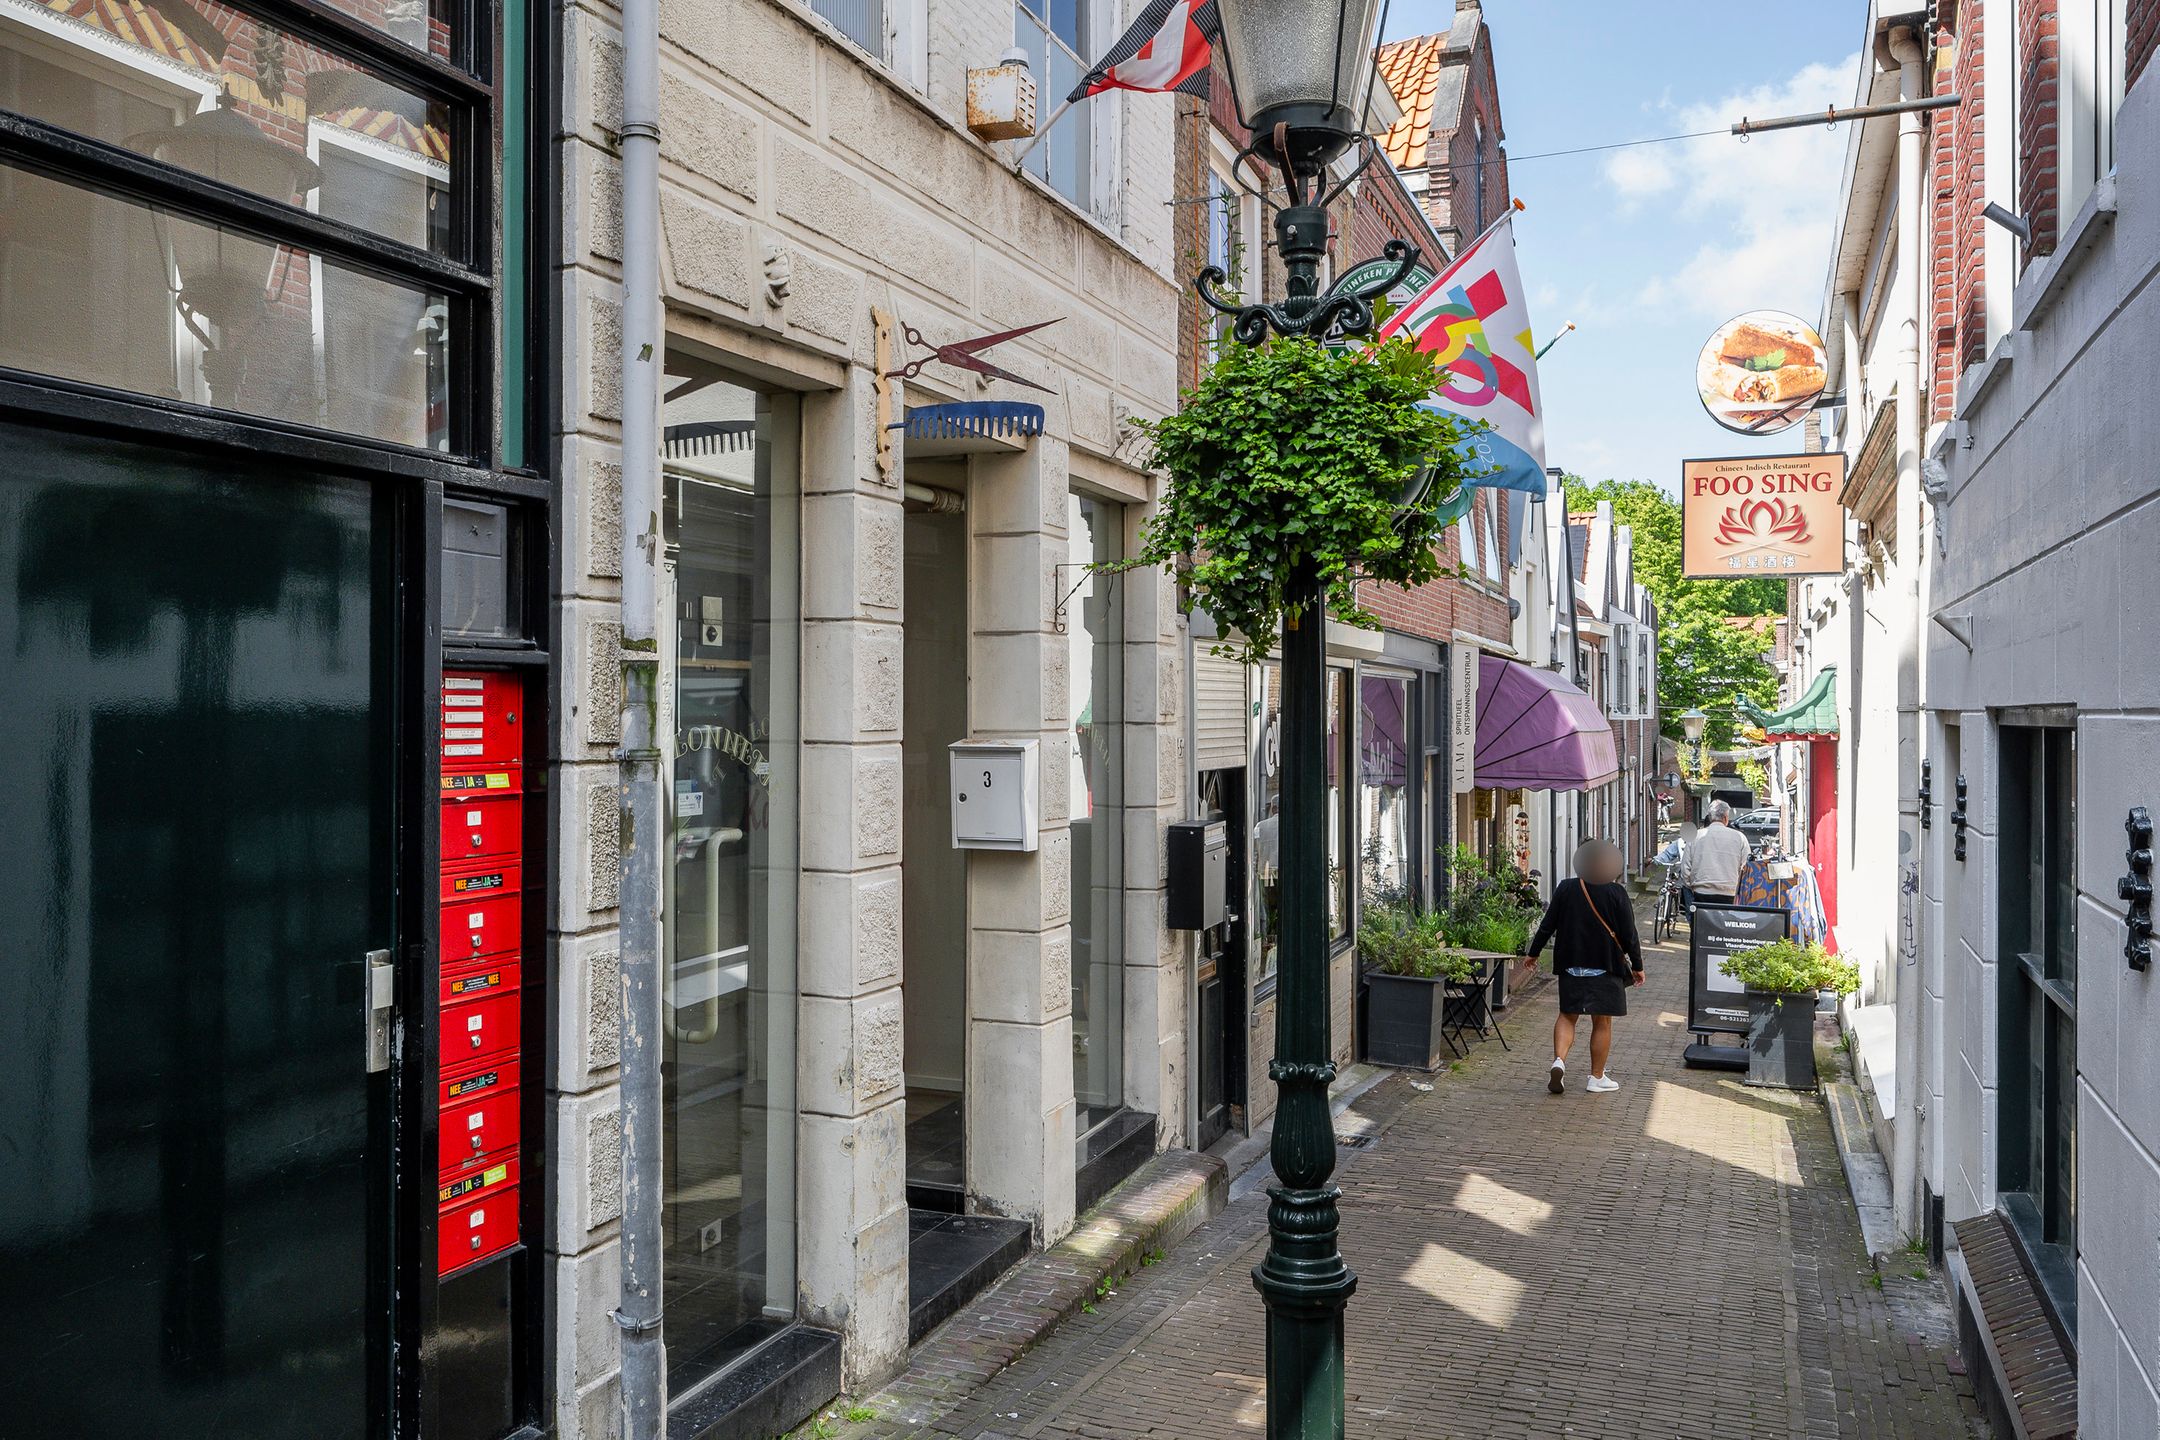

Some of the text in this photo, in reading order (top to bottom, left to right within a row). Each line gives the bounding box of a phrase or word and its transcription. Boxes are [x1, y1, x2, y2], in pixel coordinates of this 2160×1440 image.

[1715, 462, 1811, 473] Chinees Indisch Restaurant
[1693, 472, 1833, 497] FOO SING
[1464, 651, 1472, 736] ONTSPANNINGSCENTRUM
[1455, 697, 1465, 784] ALMA SPIRITUEEL
[441, 777, 454, 789] NEE
[466, 776, 476, 788] JA
[983, 770, 992, 788] 3
[455, 879, 467, 891] NEE
[483, 876, 492, 887] JA
[452, 981, 464, 993] NEE
[488, 973, 500, 985] NEE
[449, 1083, 462, 1097] NEE
[477, 1076, 486, 1087] JA
[439, 1186, 452, 1201] NEE
[465, 1179, 473, 1193] JA
